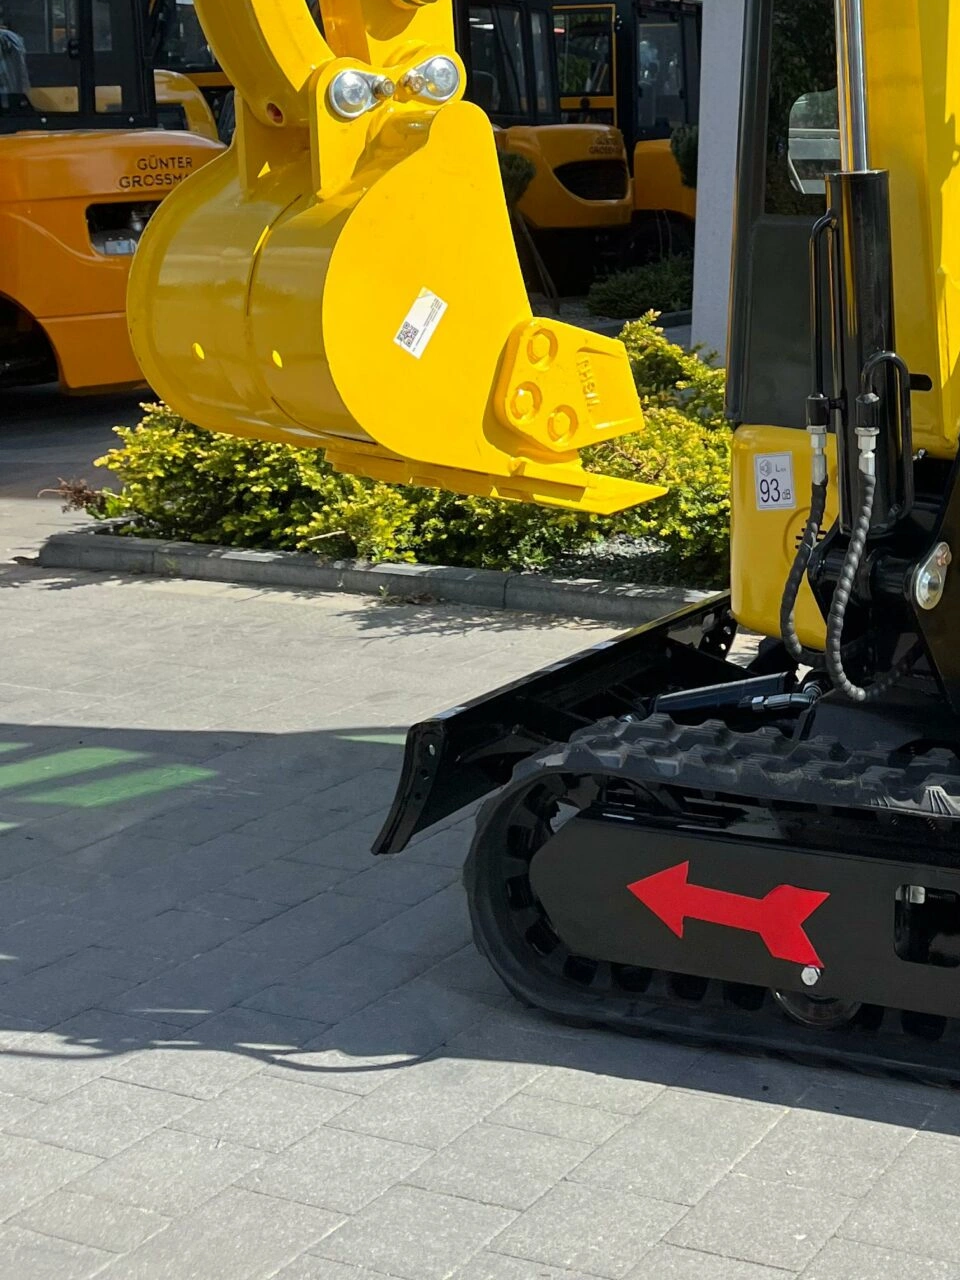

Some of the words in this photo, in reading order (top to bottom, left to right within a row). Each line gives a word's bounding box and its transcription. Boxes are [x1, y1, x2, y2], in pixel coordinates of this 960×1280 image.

[137, 155, 193, 170] GÜNTER
[119, 173, 189, 188] GROSSM
[760, 478, 780, 503] 93
[782, 488, 791, 500] dB
